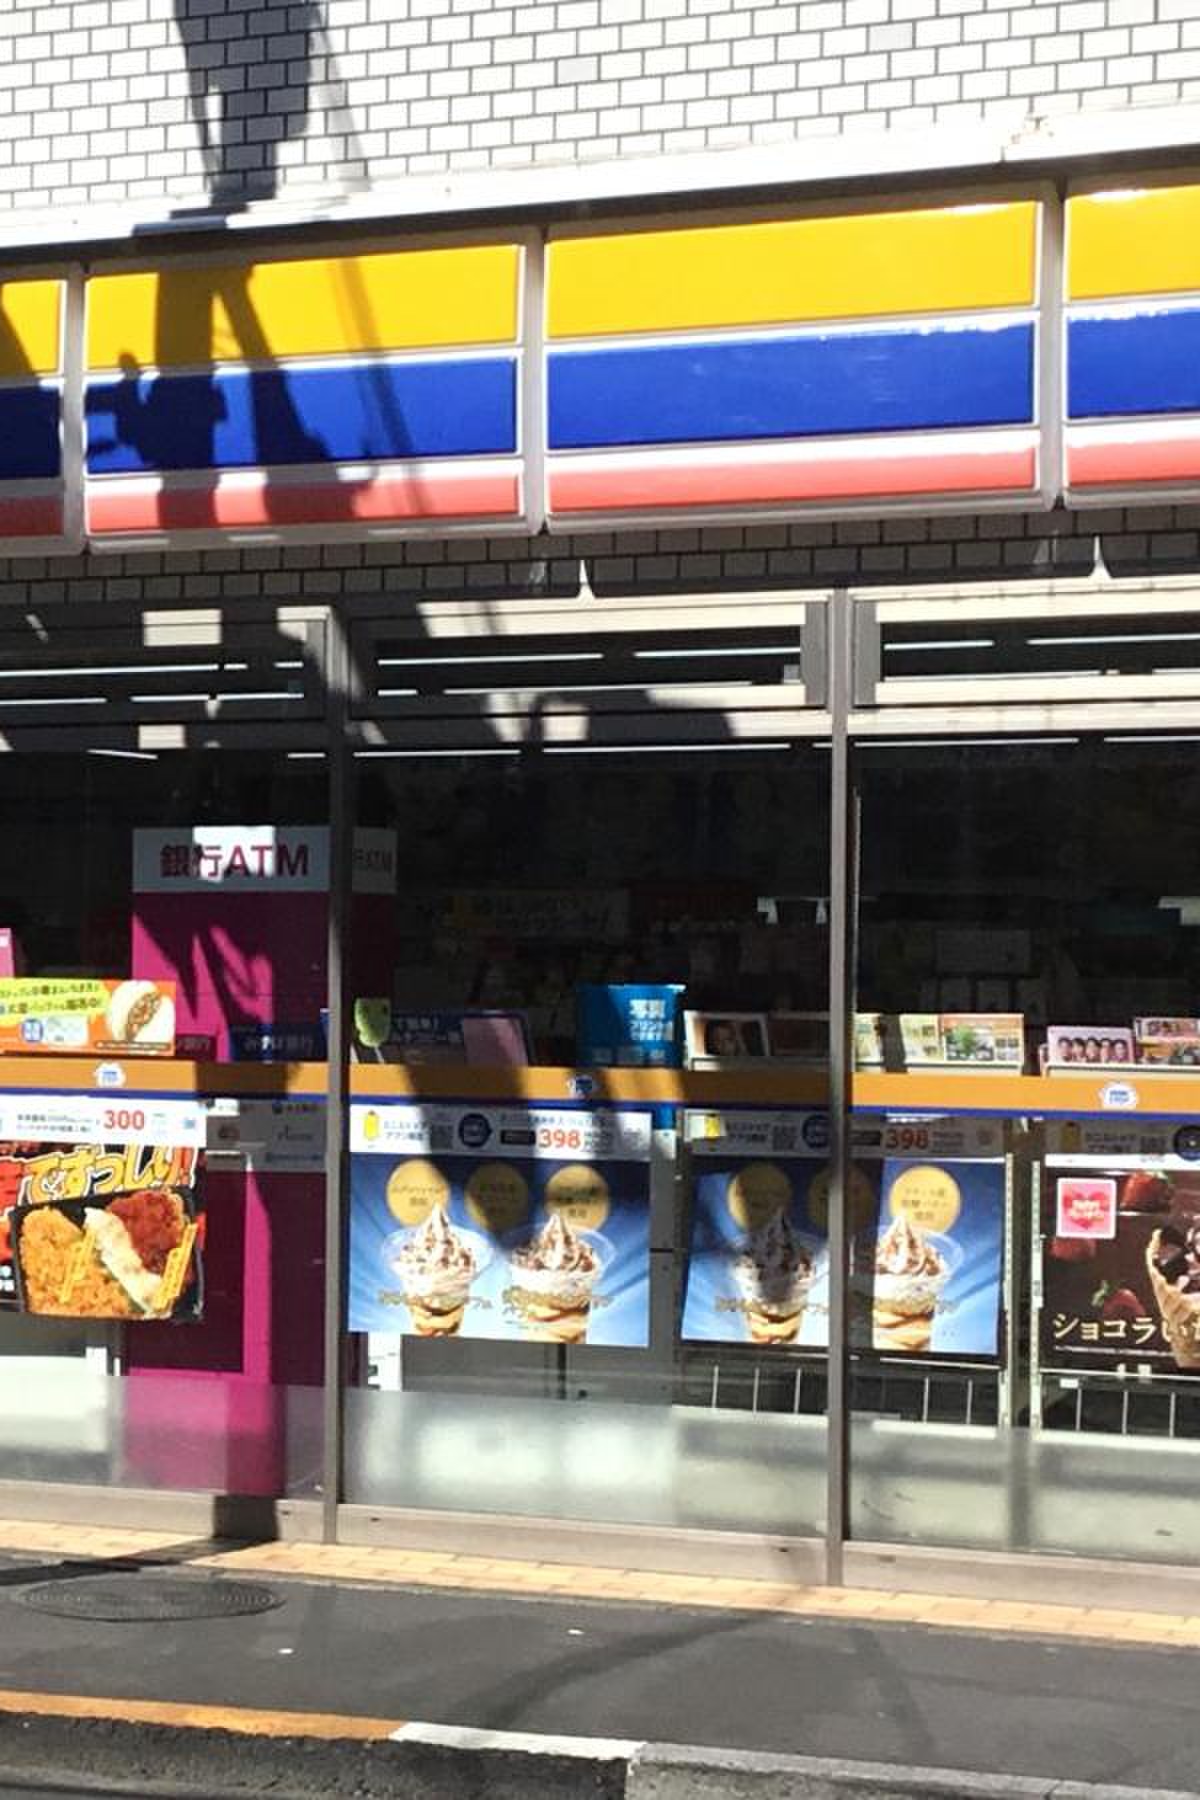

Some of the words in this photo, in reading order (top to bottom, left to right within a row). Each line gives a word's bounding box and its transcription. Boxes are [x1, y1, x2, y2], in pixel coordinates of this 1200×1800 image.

[160, 844, 308, 878] 銀行ATM
[103, 1109, 146, 1131] 300
[538, 1128, 582, 1149] 398
[885, 1128, 929, 1149] 398
